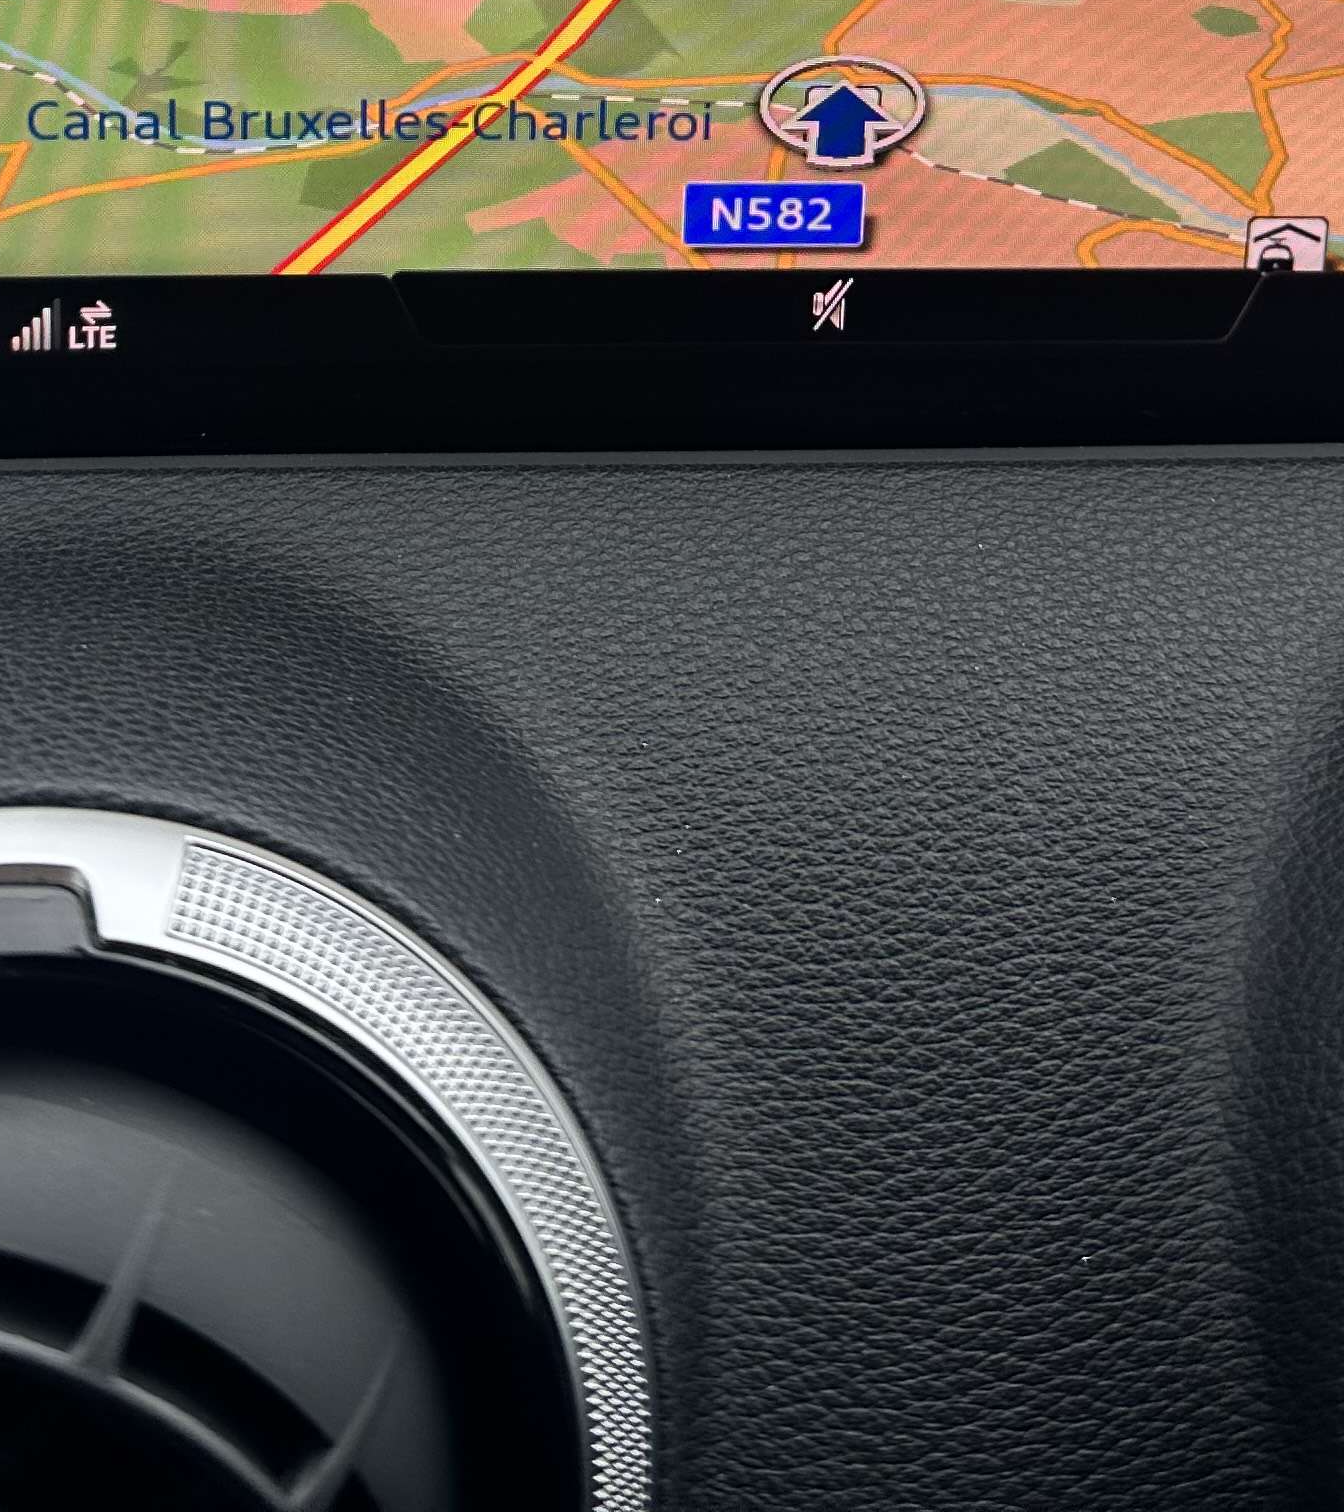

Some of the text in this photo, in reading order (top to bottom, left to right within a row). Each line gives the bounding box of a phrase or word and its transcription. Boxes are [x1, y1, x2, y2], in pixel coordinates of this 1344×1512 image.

[26, 98, 714, 143] Canal Bruxelles-Charleroi
[711, 197, 833, 233] N582
[68, 324, 117, 350] LTE
